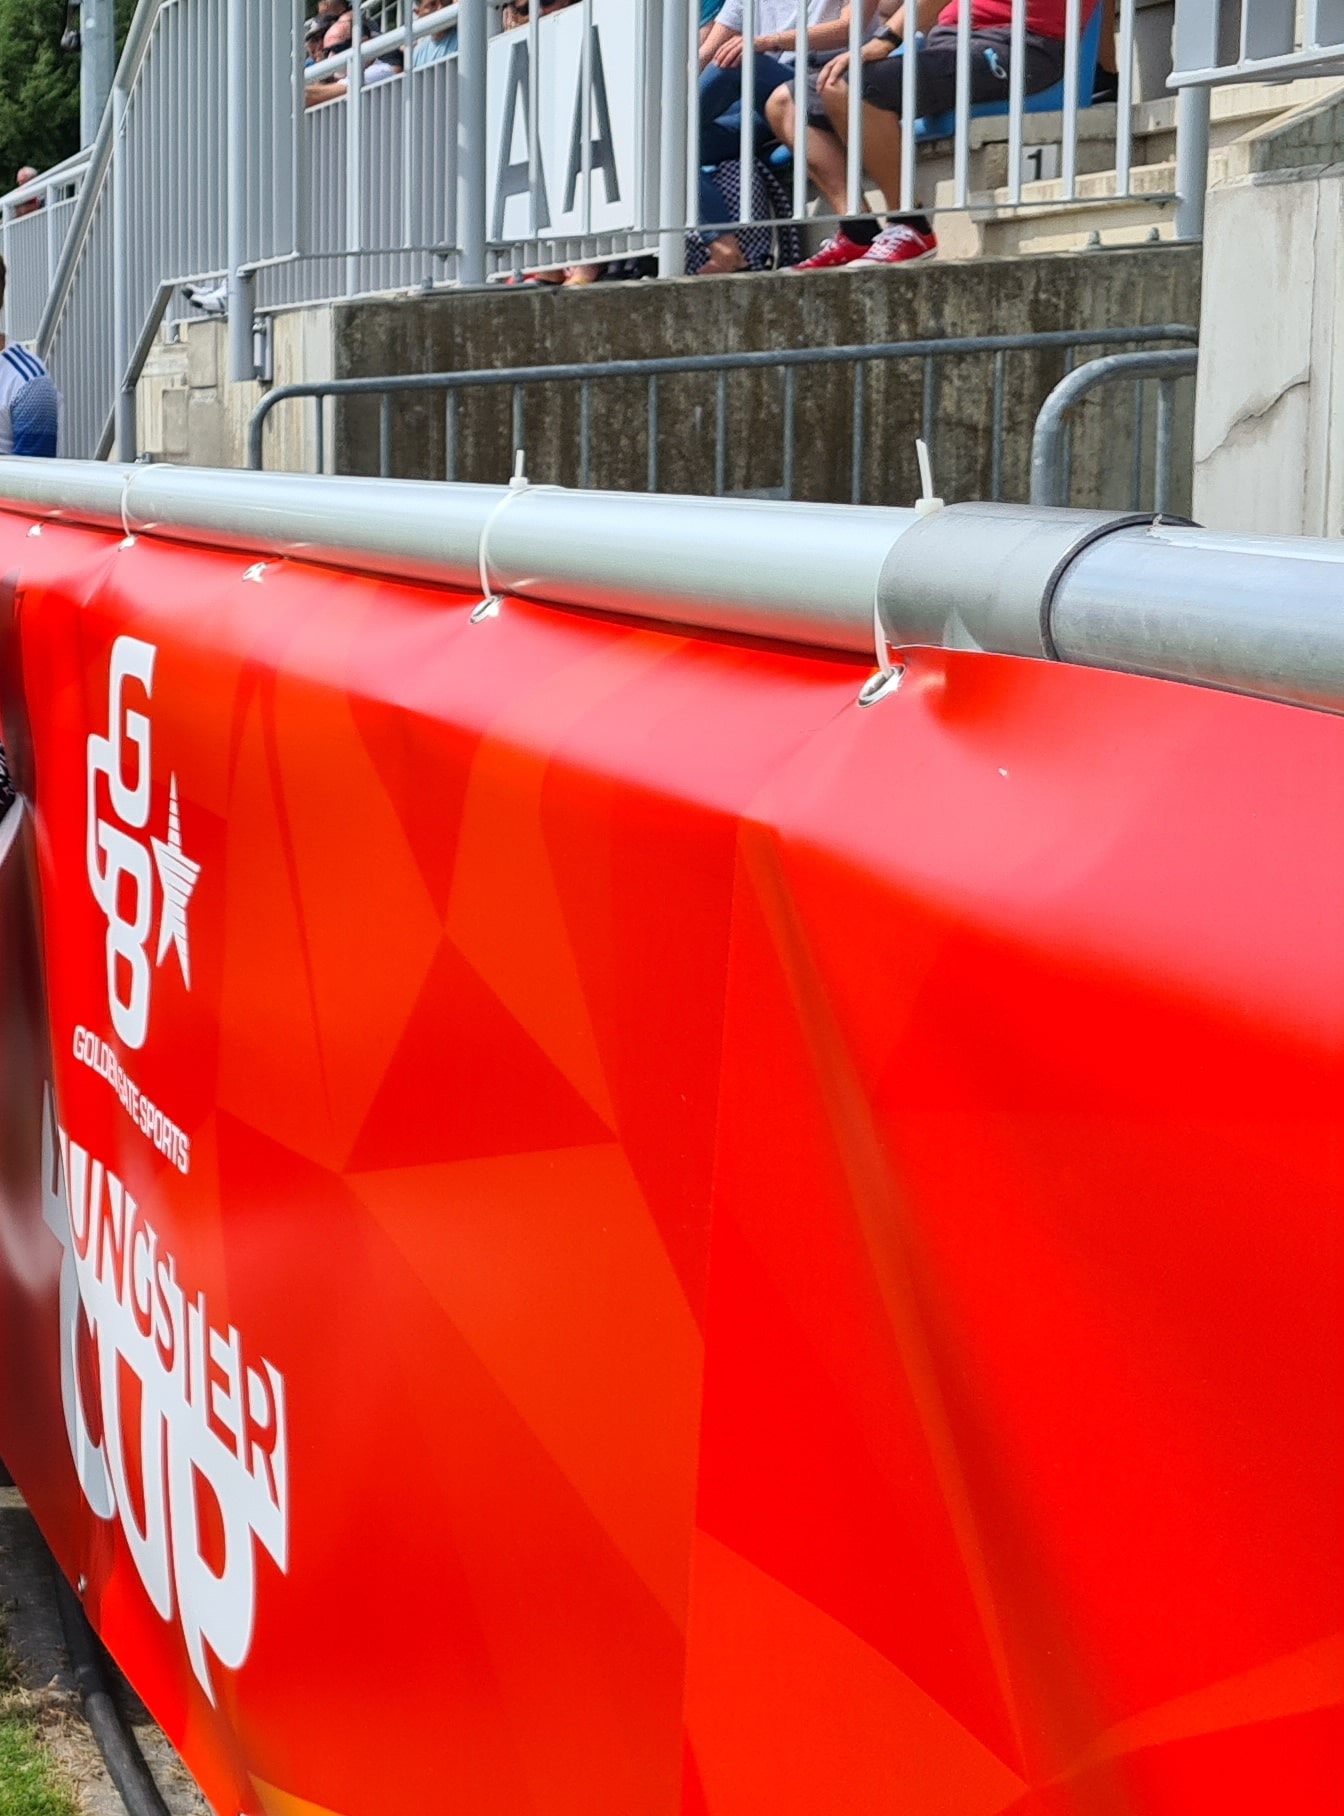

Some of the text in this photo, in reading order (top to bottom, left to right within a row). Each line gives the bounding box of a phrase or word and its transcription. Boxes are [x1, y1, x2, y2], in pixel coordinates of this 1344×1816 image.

[1028, 148, 1043, 180] 1
[139, 1094, 190, 1175] SPORTS
[47, 1130, 286, 1516] UNGSTER
[60, 1290, 258, 1710] CUP
